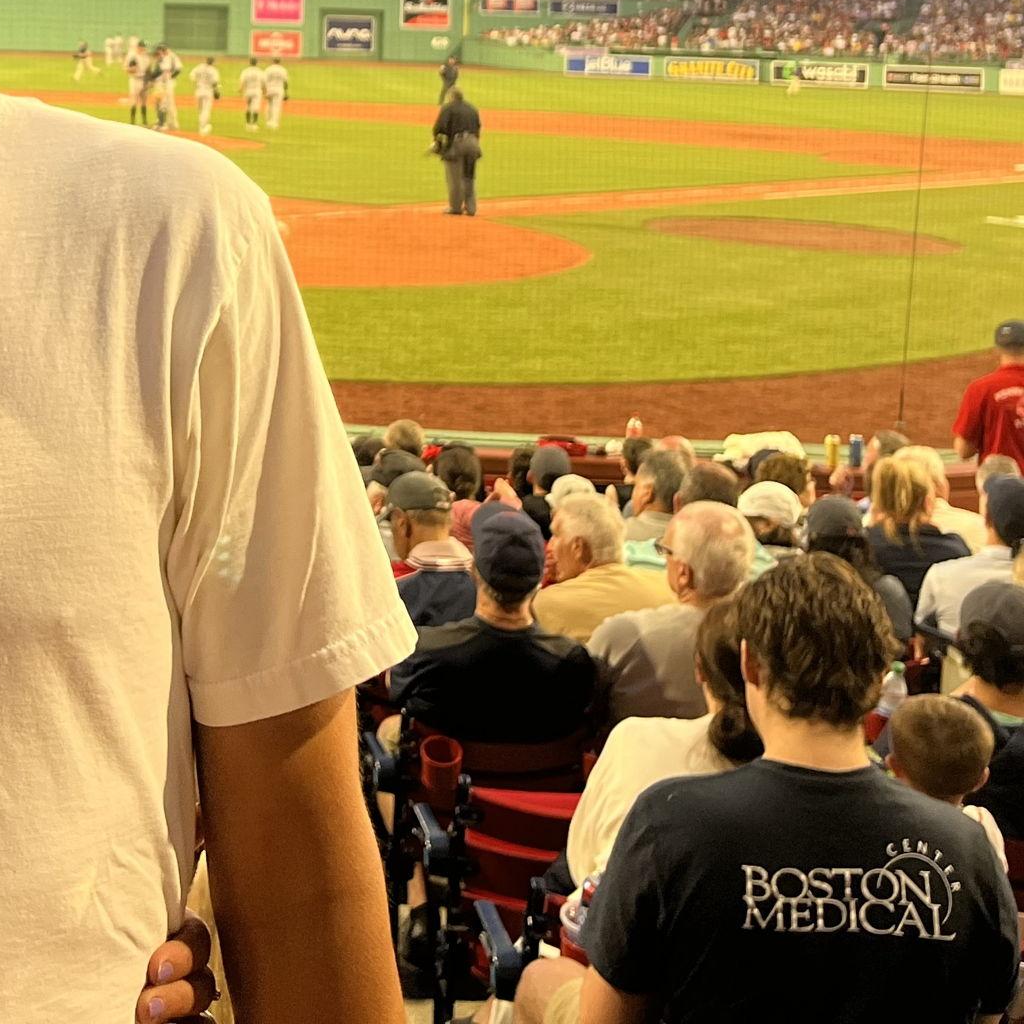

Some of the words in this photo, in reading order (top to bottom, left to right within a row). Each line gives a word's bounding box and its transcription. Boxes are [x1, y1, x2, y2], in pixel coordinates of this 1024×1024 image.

[741, 864, 936, 907] BOSTON
[885, 838, 962, 893] CENTER
[741, 894, 957, 941] MEDICAL
